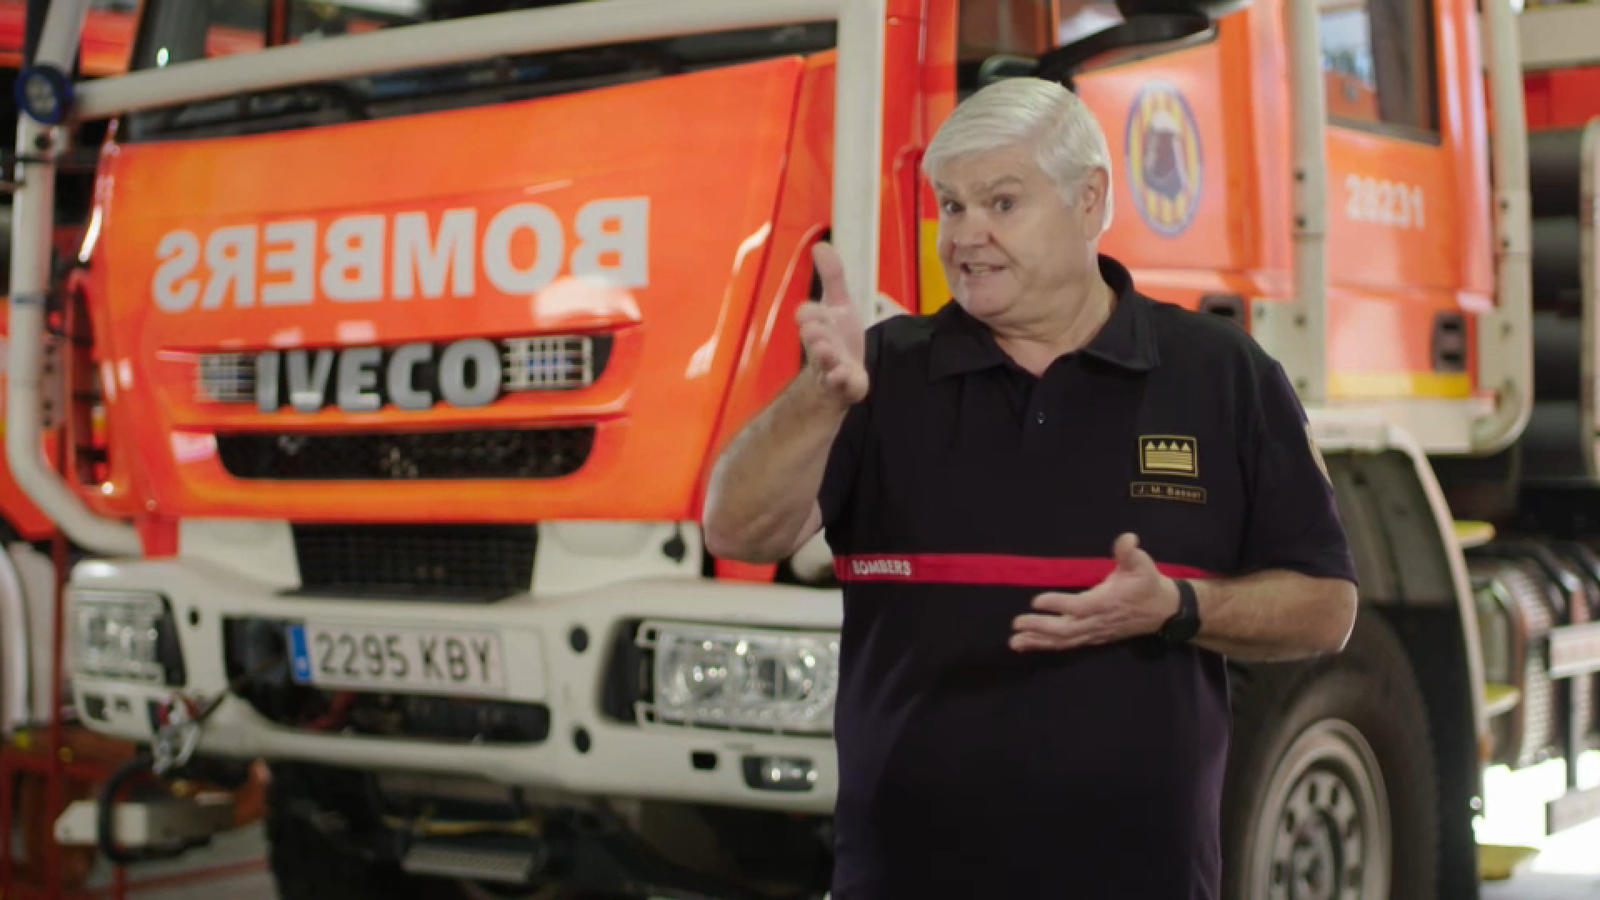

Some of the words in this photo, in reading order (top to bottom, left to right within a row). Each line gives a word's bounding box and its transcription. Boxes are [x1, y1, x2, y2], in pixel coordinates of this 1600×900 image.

[1345, 173, 1425, 229] 28231
[255, 337, 502, 414] IVECO
[852, 559, 911, 577] BOMBERS
[314, 630, 411, 679] 2295
[418, 635, 492, 683] KBY
